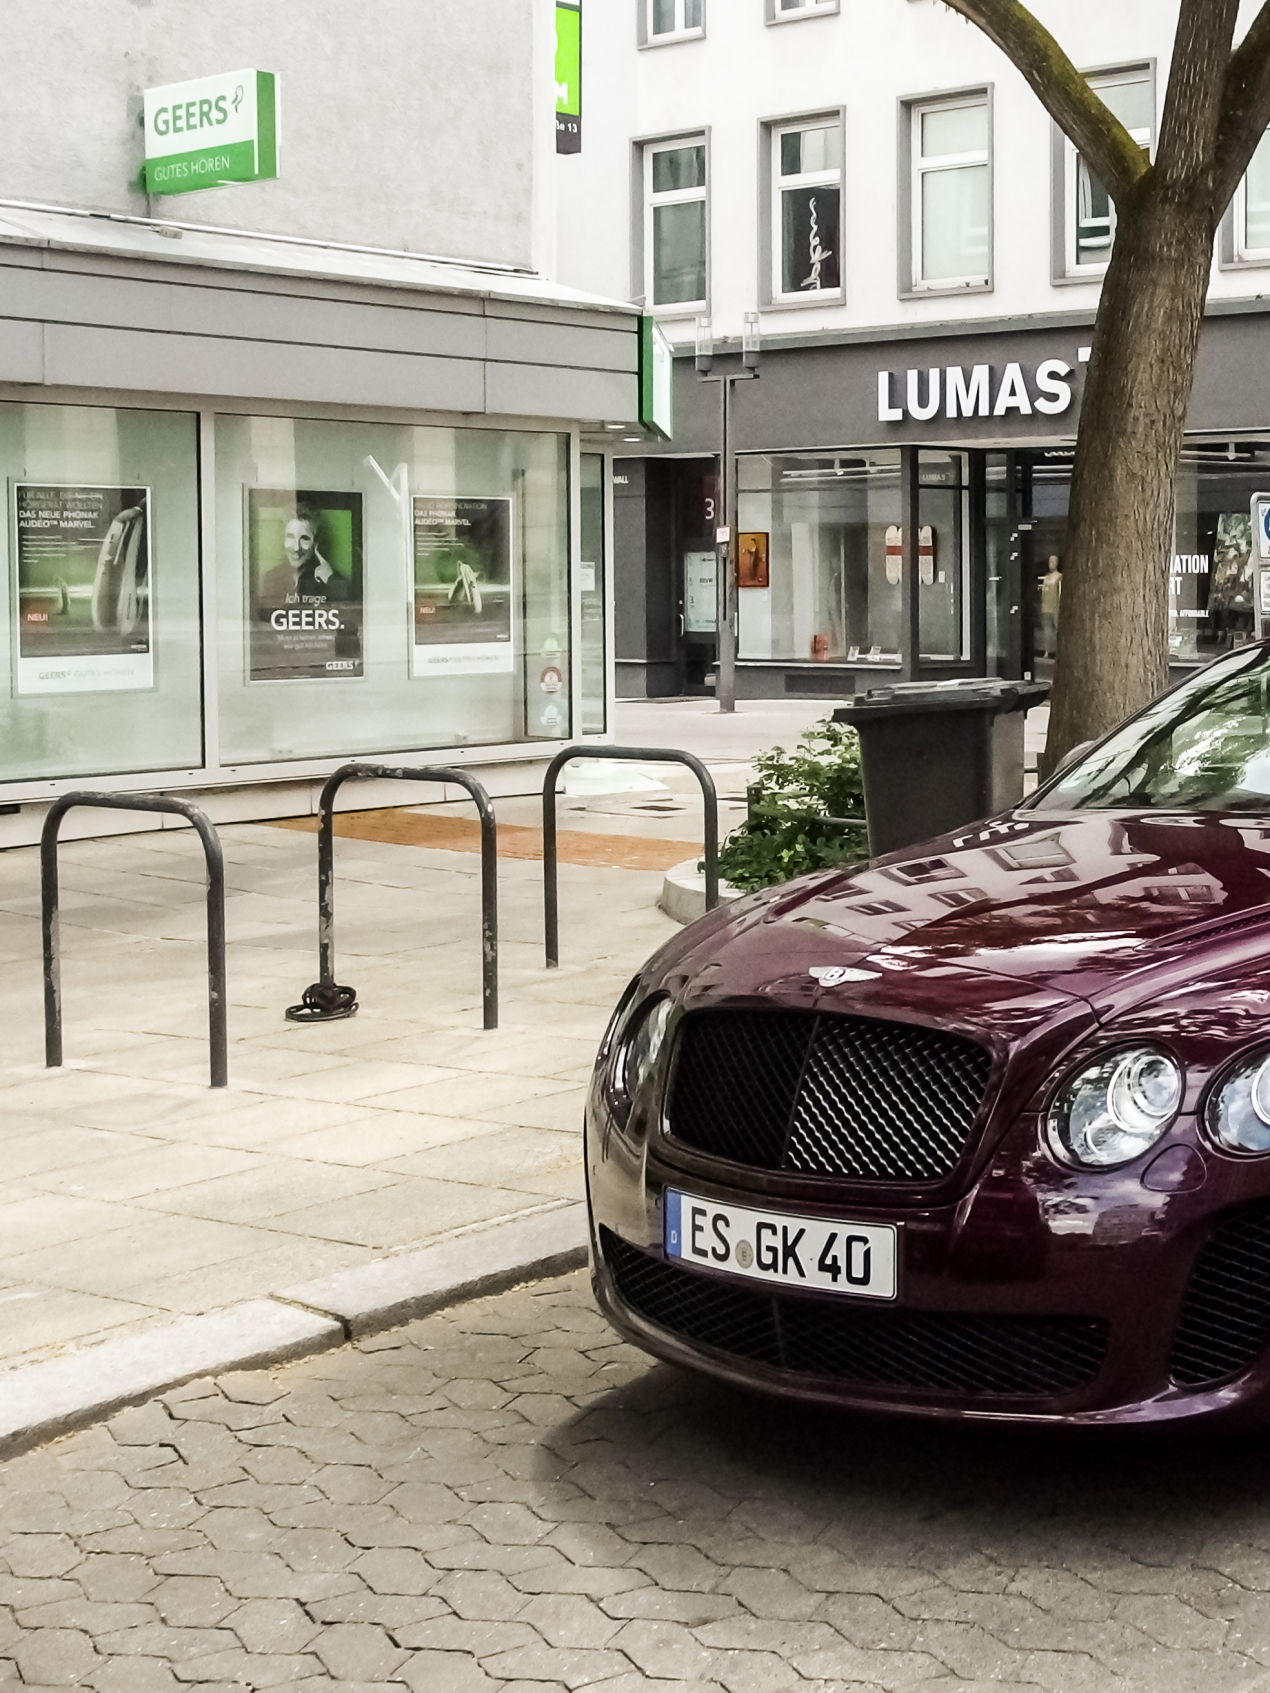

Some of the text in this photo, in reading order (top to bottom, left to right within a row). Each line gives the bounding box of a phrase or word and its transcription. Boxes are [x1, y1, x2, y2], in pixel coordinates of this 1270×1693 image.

[153, 95, 228, 136] GEERS
[568, 123, 577, 133] 13
[154, 155, 230, 181] GUTES HÖREN
[877, 358, 1072, 422] LUMAS
[19, 510, 99, 519] DAS NEUE PHONAK
[285, 592, 328, 607] Ich trage
[27, 613, 48, 621] NEU!
[270, 609, 345, 631] GEERS.
[325, 660, 354, 671] GEERS
[38, 670, 66, 680] GEERS
[670, 1230, 678, 1244] D
[691, 1205, 871, 1287] ES GK 40
